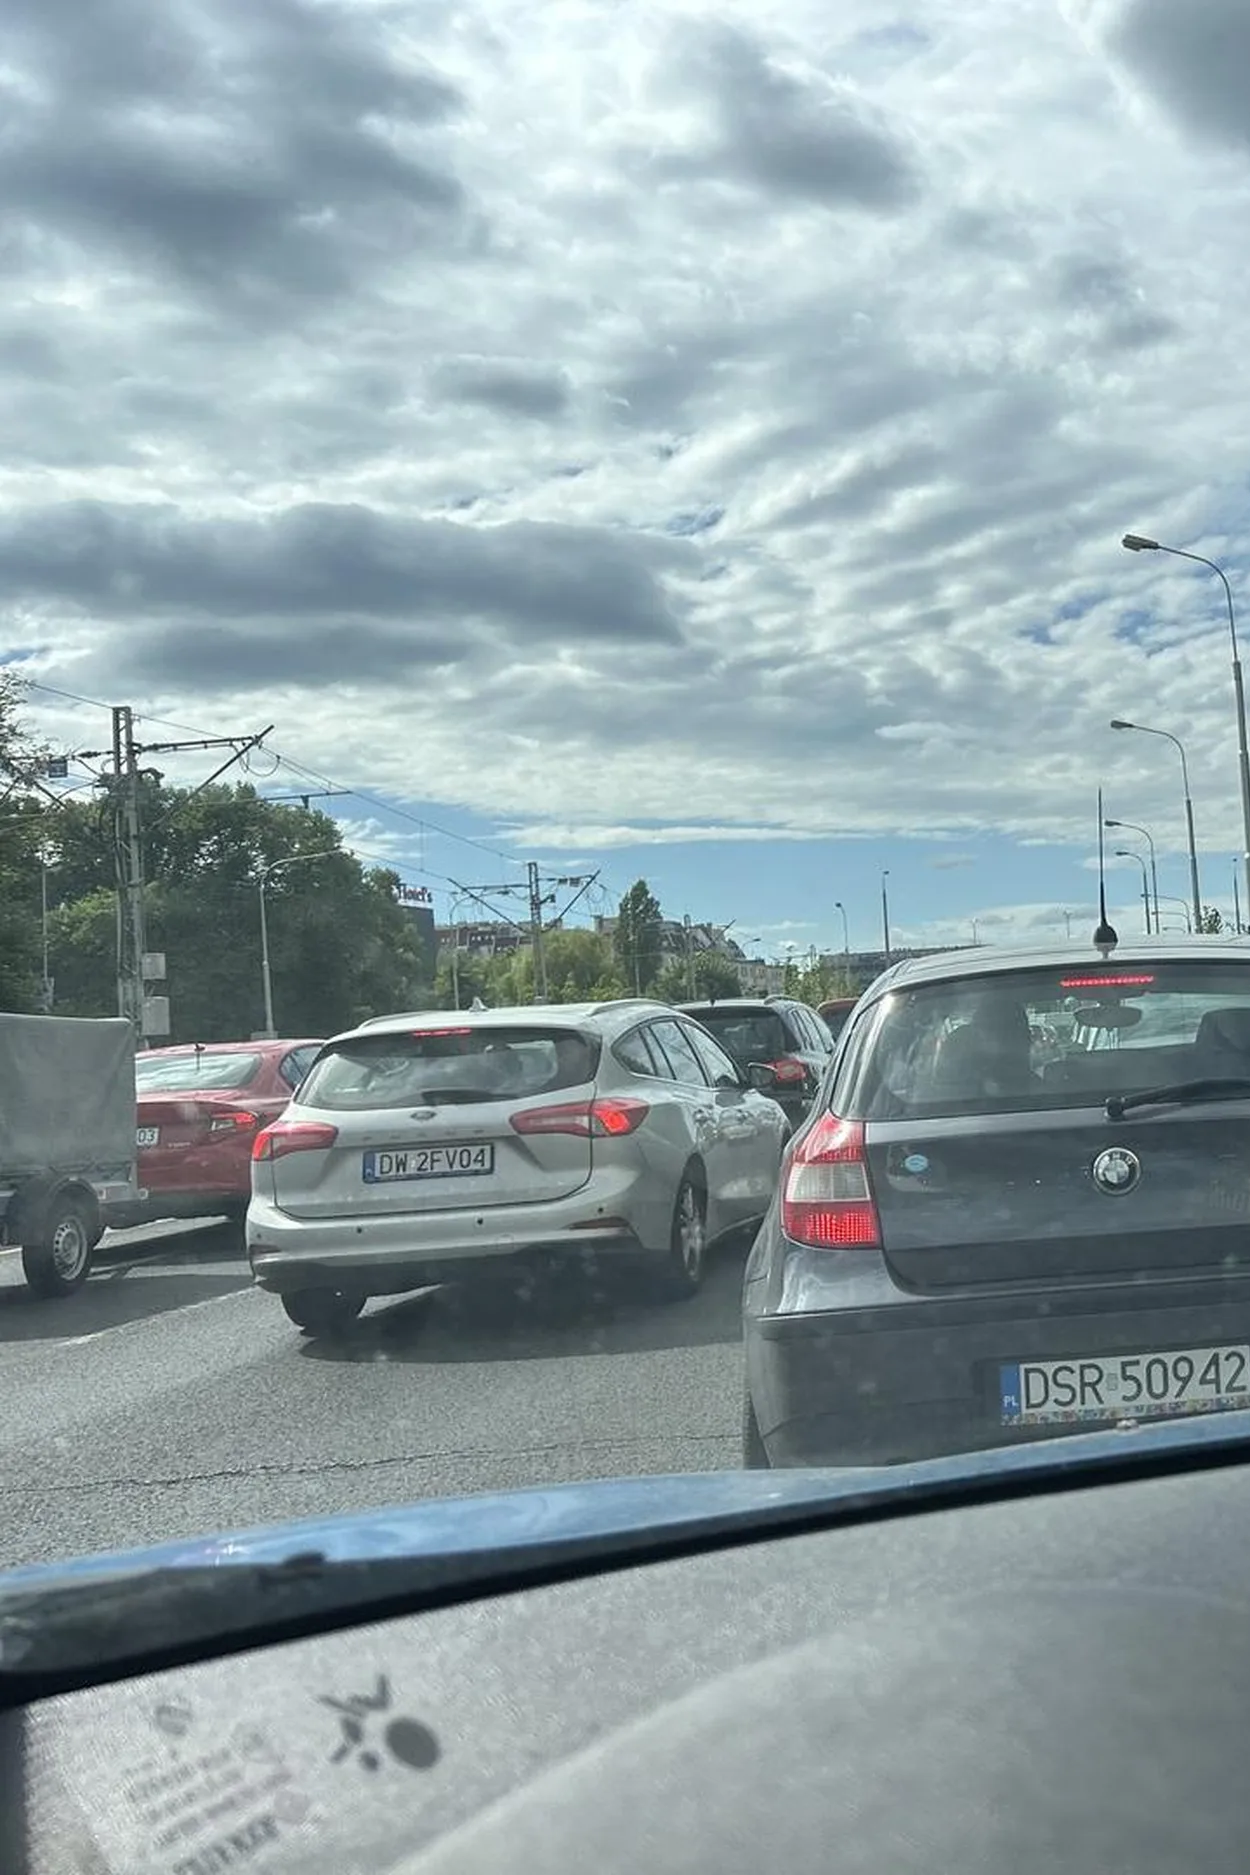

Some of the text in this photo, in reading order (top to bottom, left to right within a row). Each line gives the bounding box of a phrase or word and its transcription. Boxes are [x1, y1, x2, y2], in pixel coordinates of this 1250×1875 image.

[138, 1129, 155, 1143] 03
[380, 1148, 485, 1174] DW 2FV04
[1023, 1351, 1247, 1408] DSR 50942
[1004, 1395, 1019, 1407] PL
